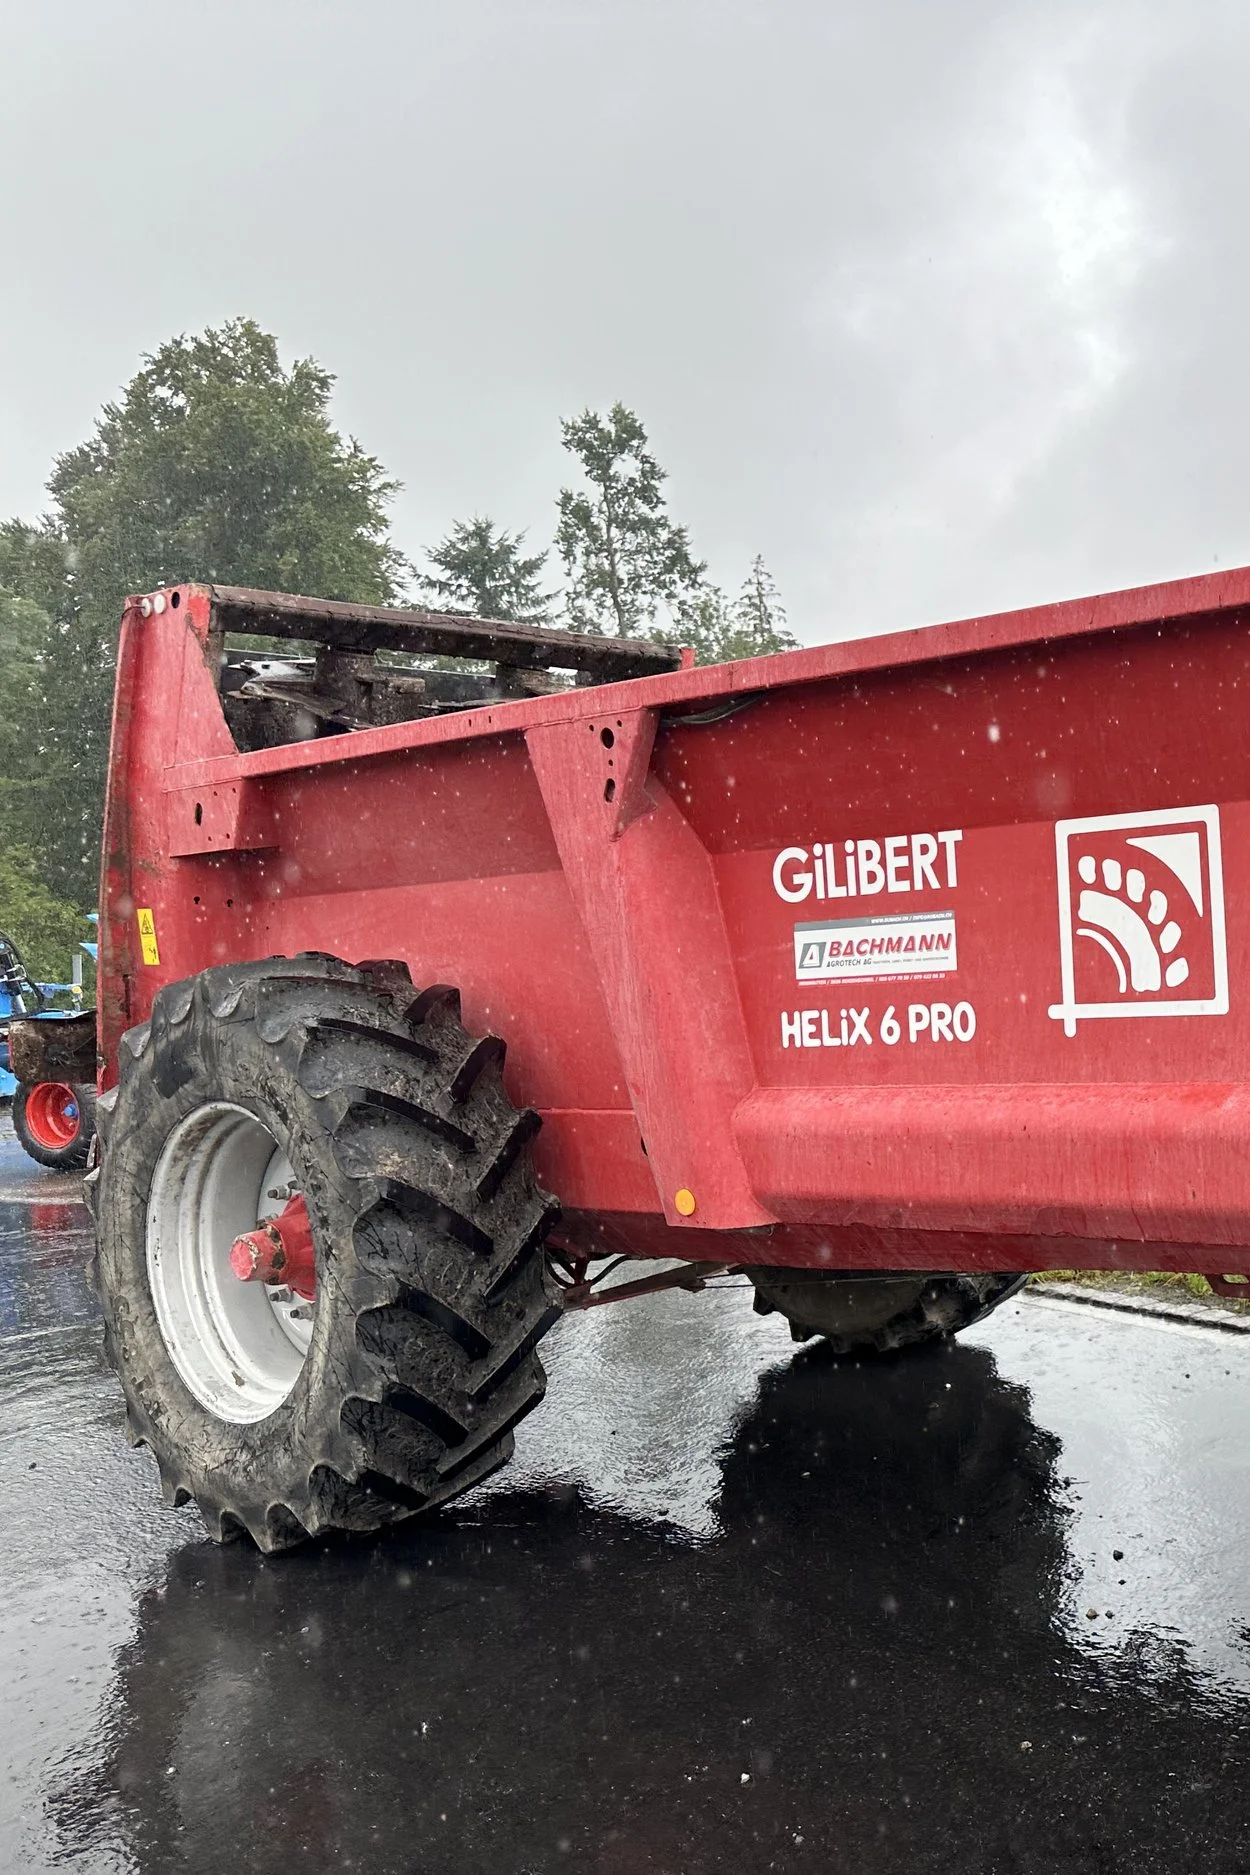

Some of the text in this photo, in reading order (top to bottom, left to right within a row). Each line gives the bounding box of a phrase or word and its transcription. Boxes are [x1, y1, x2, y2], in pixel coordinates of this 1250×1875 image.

[829, 932, 952, 957] BACHMANN
[826, 958, 861, 968] AGROTECH
[863, 957, 872, 965] AG
[880, 1005, 901, 1045] 6
[908, 1001, 976, 1043] PRO
